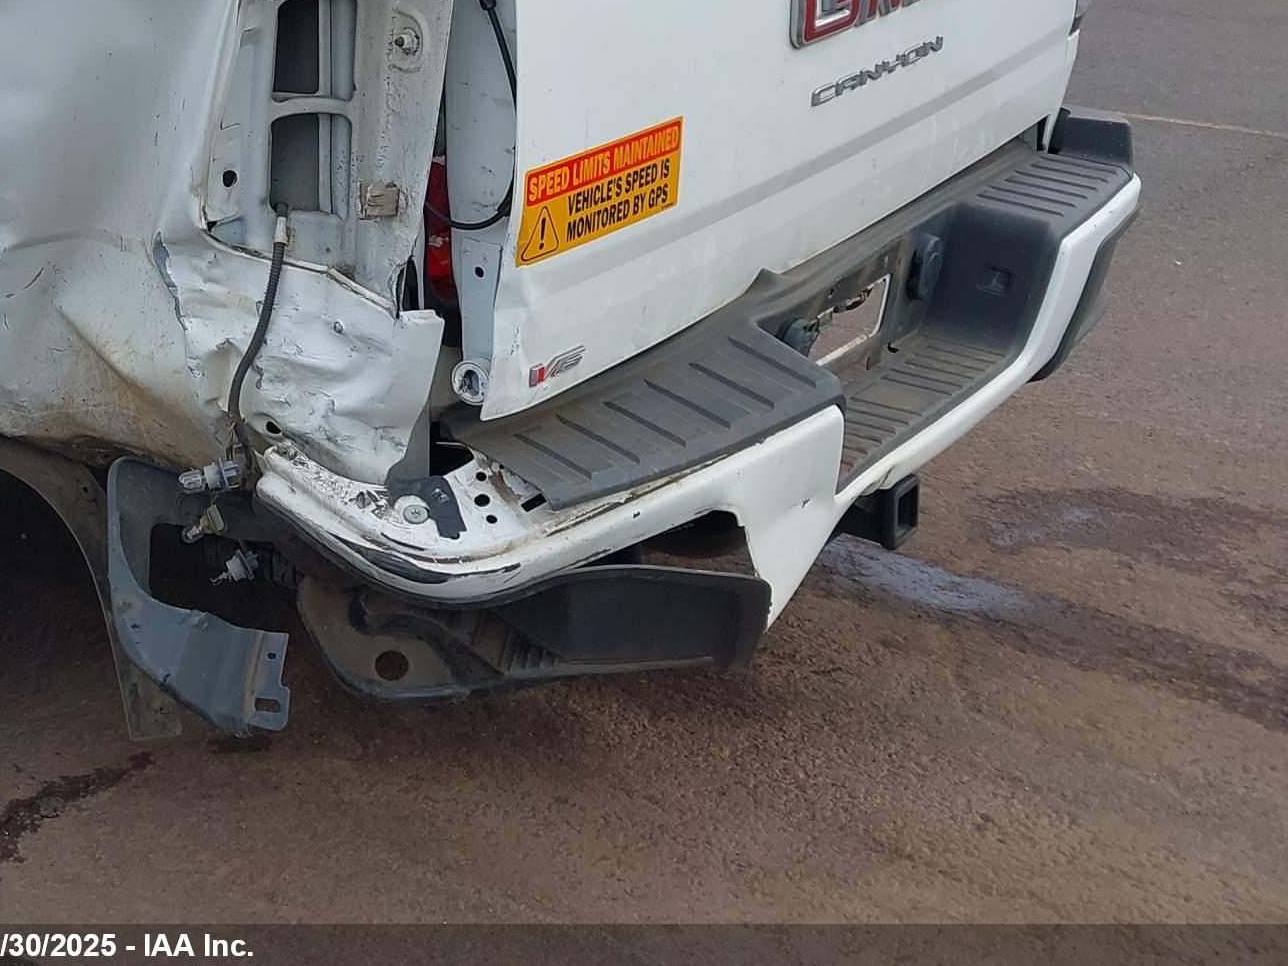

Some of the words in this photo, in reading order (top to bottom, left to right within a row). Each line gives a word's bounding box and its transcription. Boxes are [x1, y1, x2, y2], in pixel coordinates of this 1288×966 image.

[810, 35, 944, 107] CANYON
[528, 166, 570, 202] SPEED
[572, 150, 611, 186] LIMITS
[613, 125, 680, 171] MAINTAINED
[567, 175, 623, 216] VEHICLE'S
[624, 162, 658, 194] SPEED
[660, 157, 670, 179] IS
[566, 202, 631, 243] MONITORED
[632, 193, 647, 216] BY
[648, 183, 669, 210] GPS
